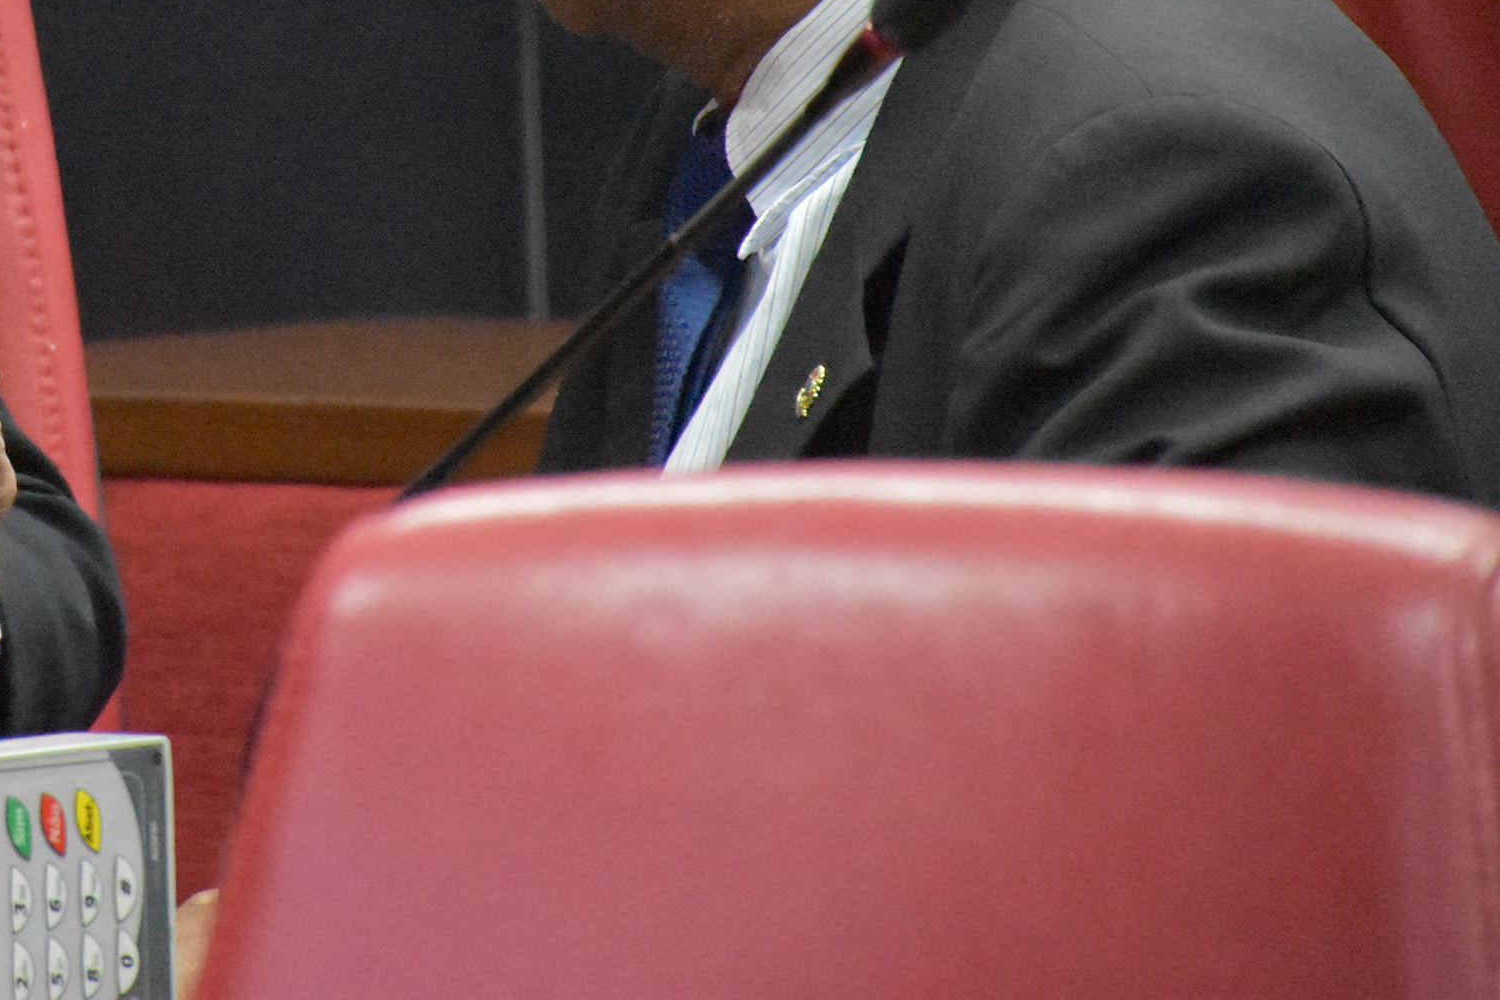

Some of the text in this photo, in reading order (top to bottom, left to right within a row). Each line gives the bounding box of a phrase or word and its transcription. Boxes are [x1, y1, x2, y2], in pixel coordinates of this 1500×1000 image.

[13, 807, 25, 845] Sim
[49, 803, 62, 843] Não
[50, 900, 62, 912] 6
[85, 895, 97, 908] 9
[14, 903, 27, 915] 3
[121, 955, 133, 968] 0
[51, 973, 63, 987] 5
[87, 969, 99, 982] 8
[16, 977, 28, 990] 2
